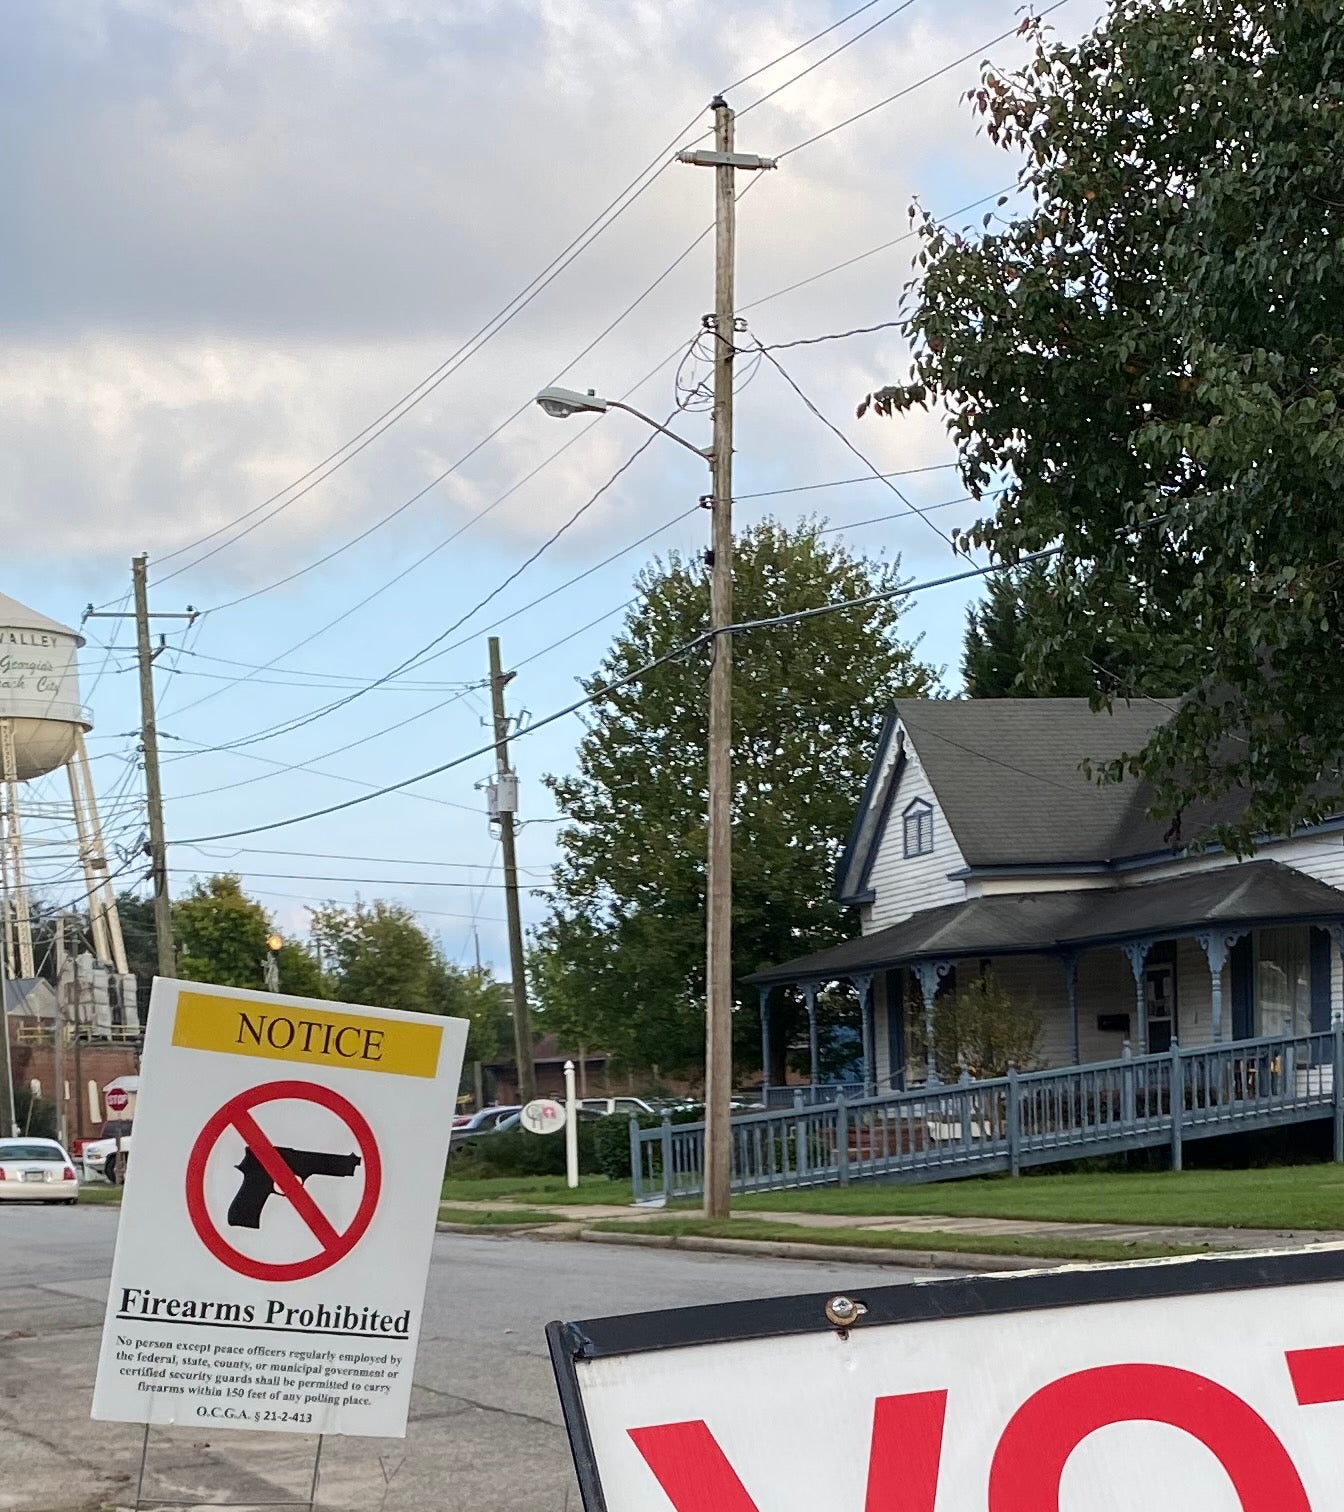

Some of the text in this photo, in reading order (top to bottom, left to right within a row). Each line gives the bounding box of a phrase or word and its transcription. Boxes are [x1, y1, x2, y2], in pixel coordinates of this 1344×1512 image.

[36, 676, 60, 697] City
[235, 1012, 385, 1062] NOTICE
[107, 1094, 128, 1105] STOP
[119, 1288, 411, 1334] Firearms Prohibited
[116, 1335, 403, 1367] No person except peace officers regularly employed by
[116, 1351, 399, 1379] the federal, state, county, or municipal government or
[119, 1366, 391, 1396] certified security guards shall be permitted to carry
[137, 1381, 372, 1407] firearms within 150 feet of any polling place.
[196, 1406, 252, 1420] O.C.G.A.
[263, 1411, 313, 1423] 21-2-413
